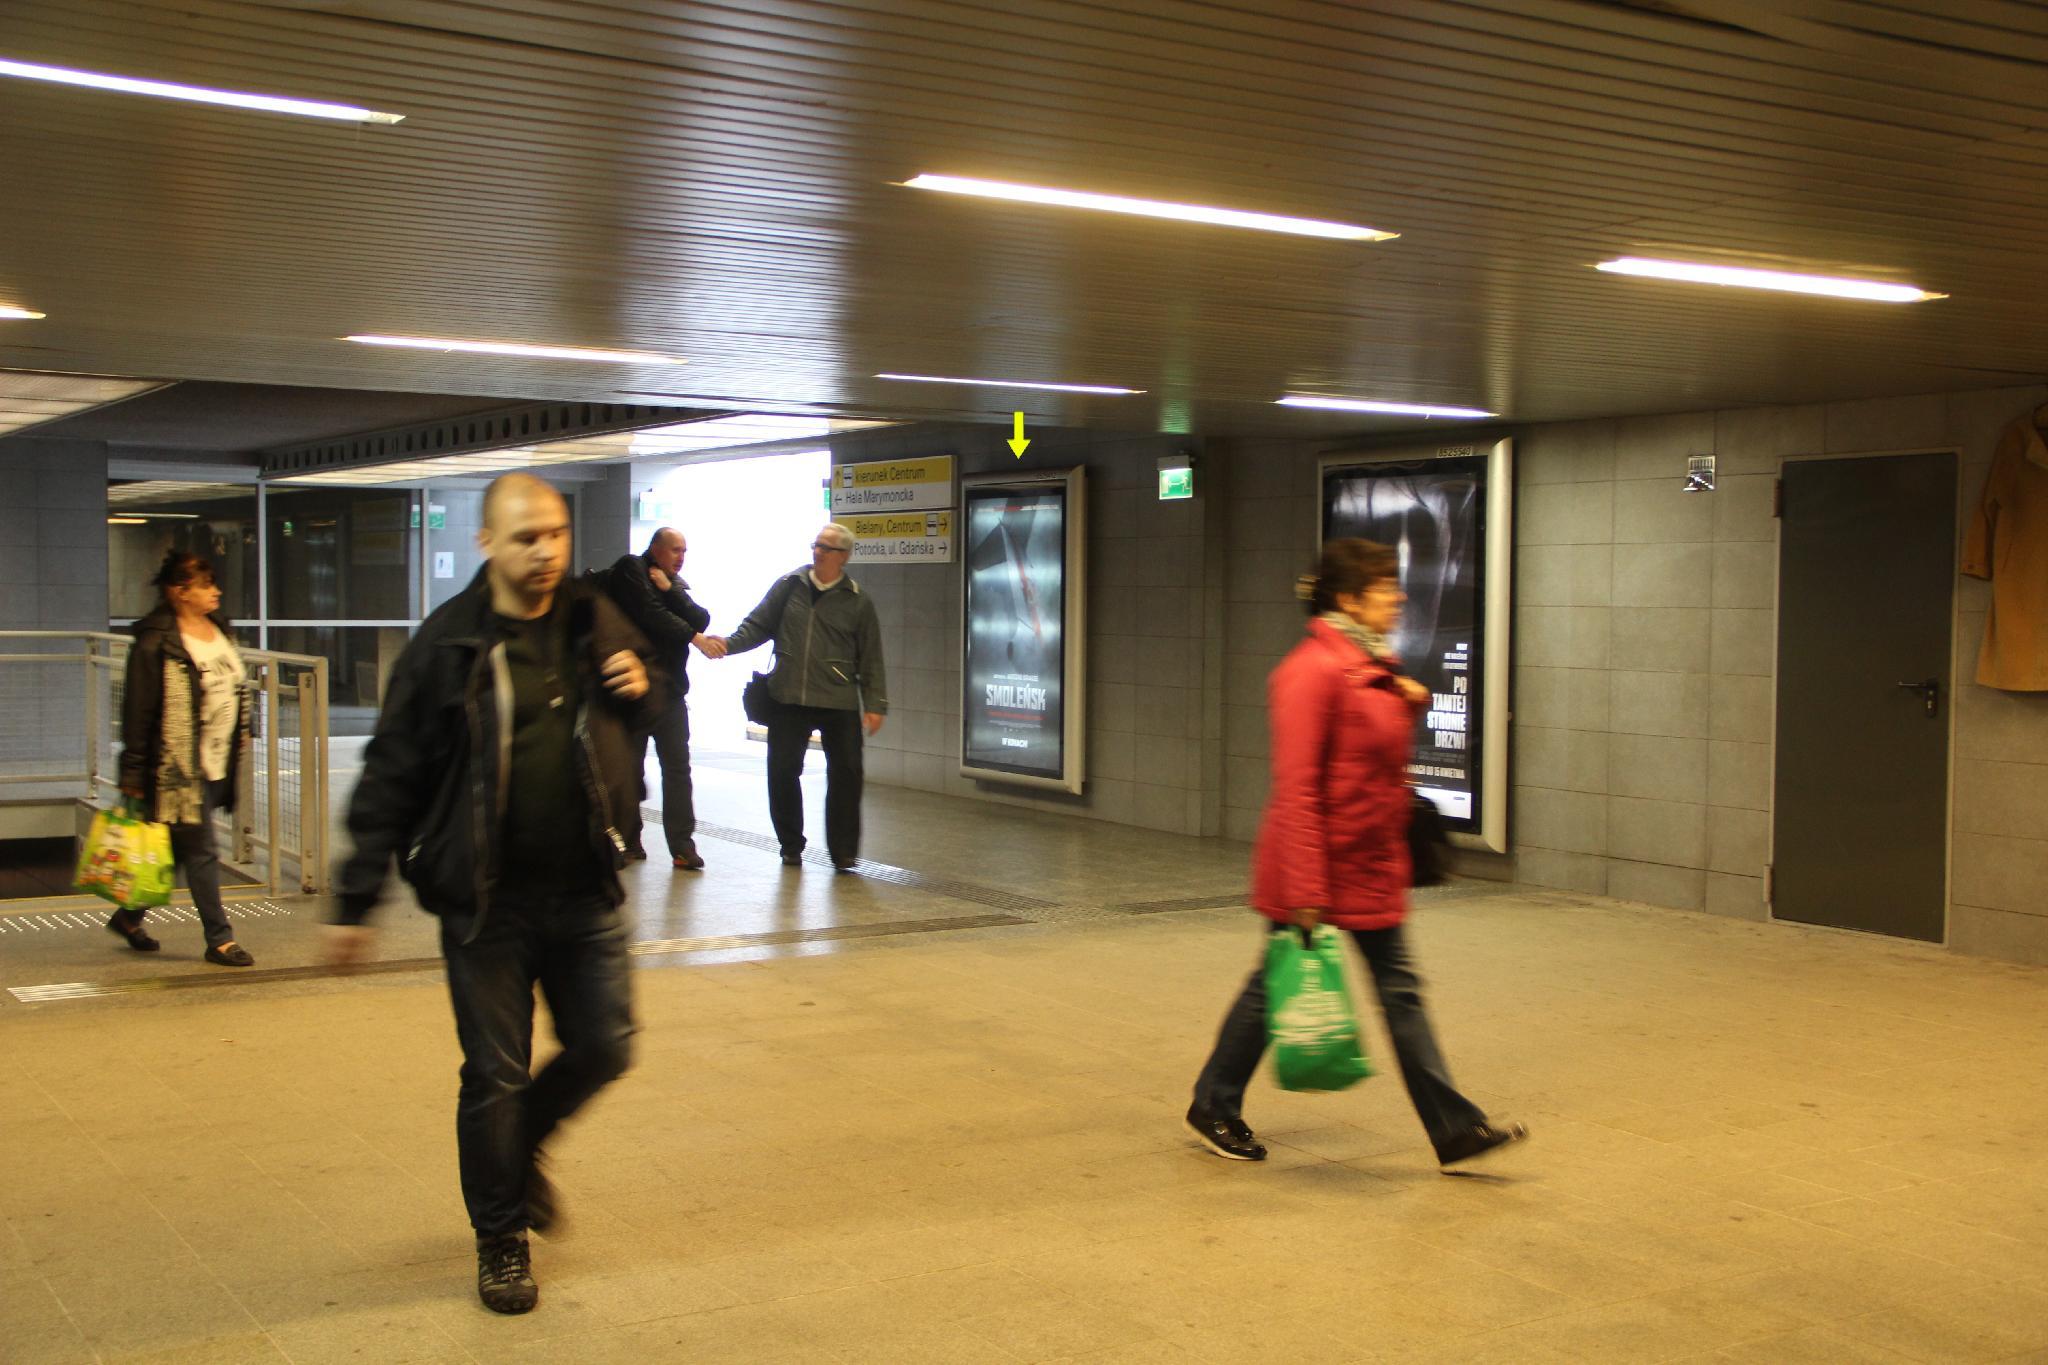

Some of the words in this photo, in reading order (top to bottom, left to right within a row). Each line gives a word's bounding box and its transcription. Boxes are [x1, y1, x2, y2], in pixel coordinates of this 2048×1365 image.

[889, 466, 925, 480] Centrum
[886, 519, 922, 533] Centrum
[1453, 676, 1467, 694] PO
[986, 683, 1046, 711] SMOLEŃSK
[1432, 693, 1466, 712] TAMTEJ
[1427, 711, 1466, 731] STRONIE
[1435, 731, 1466, 749] DRZWI
